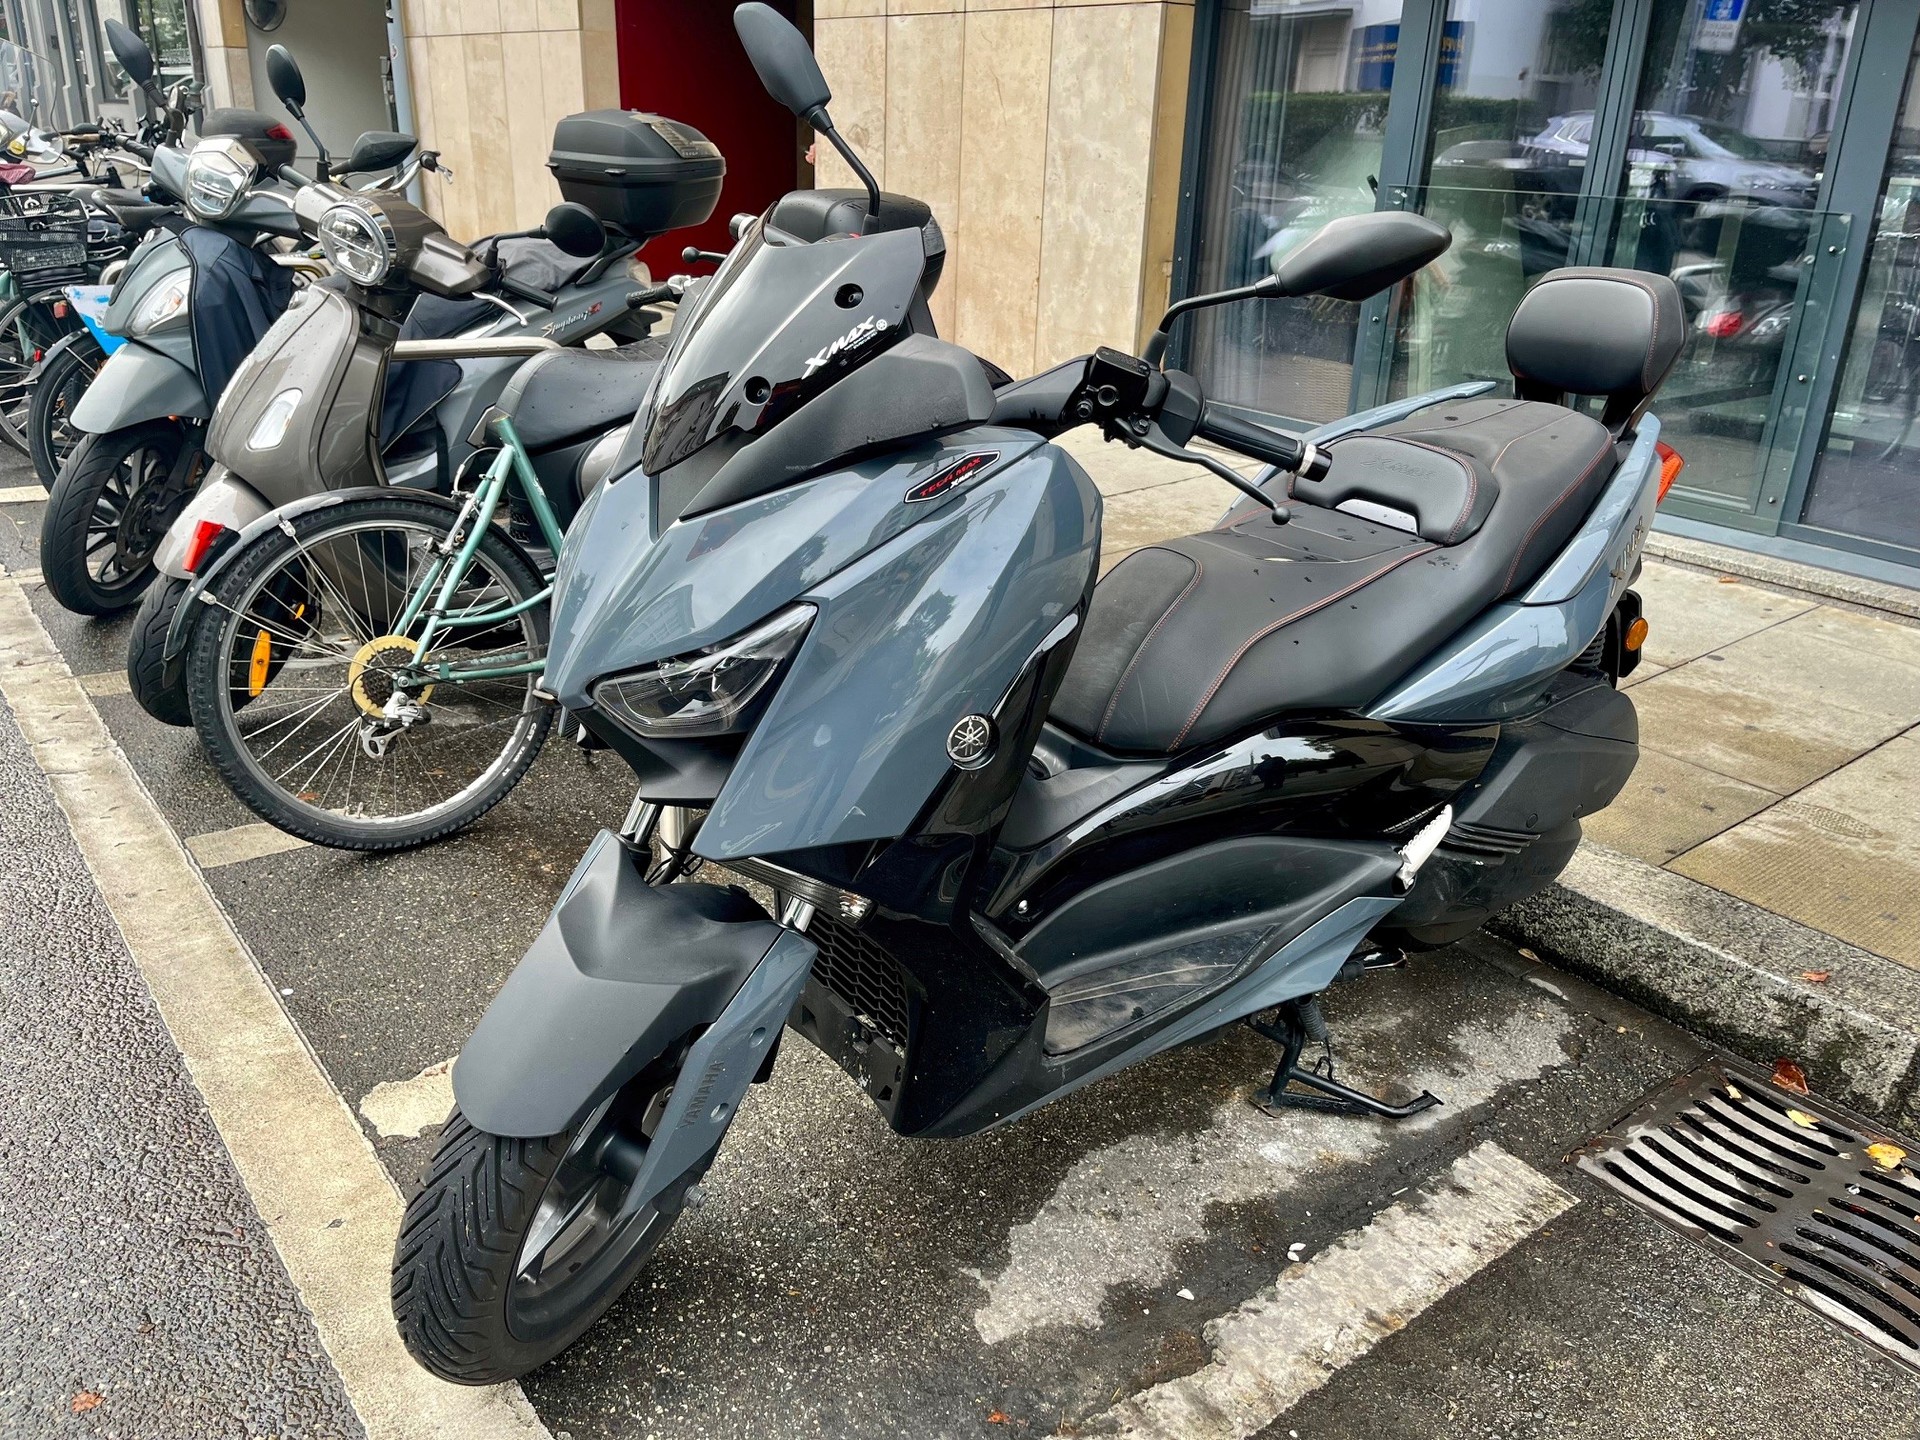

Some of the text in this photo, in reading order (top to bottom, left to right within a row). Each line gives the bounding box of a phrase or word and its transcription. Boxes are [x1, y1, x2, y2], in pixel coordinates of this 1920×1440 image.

[801, 315, 874, 380] XMAX
[920, 457, 981, 497] TECH MAX
[679, 1060, 725, 1128] YAMAHA
